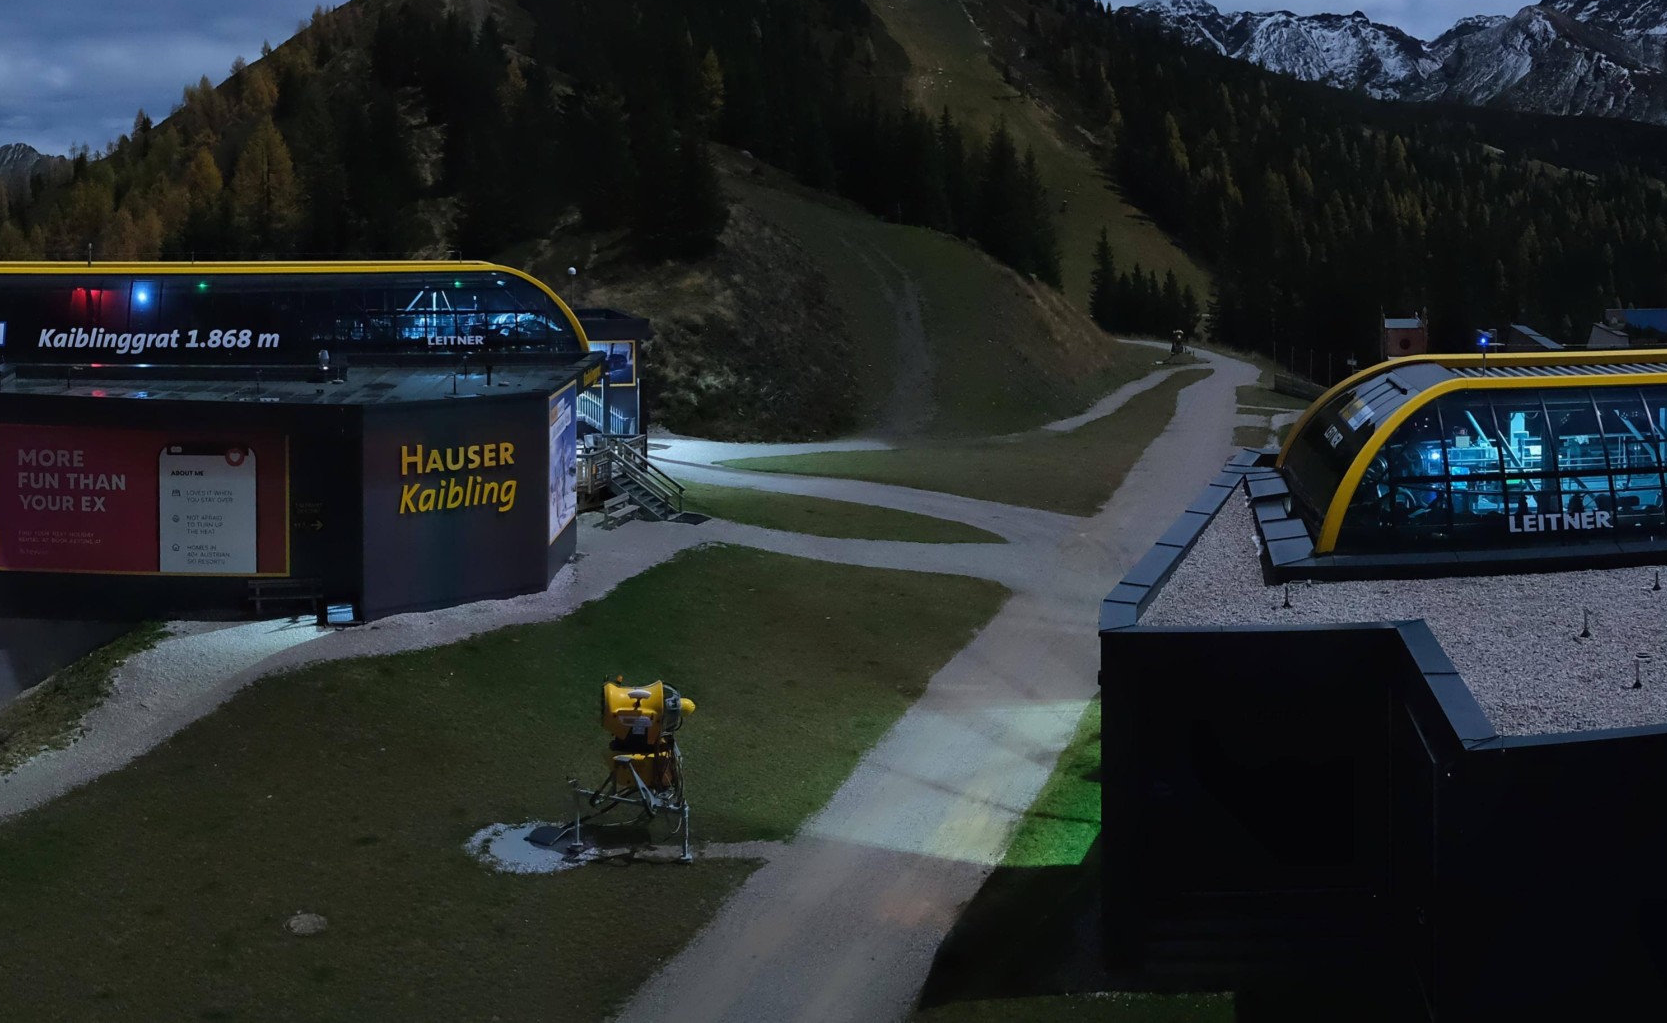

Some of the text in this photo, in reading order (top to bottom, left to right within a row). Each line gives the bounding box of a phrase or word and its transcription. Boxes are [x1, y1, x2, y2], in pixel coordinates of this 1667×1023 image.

[38, 328, 280, 354] Kaiblinggrat 1.868 m
[427, 335, 484, 345] LEITNER
[18, 449, 84, 467] MORE
[401, 442, 515, 475] HAUSER
[18, 472, 126, 490] FUN THAN
[19, 494, 106, 512] YOUR EX
[400, 475, 517, 514] Kaibling
[1509, 511, 1614, 533] LEITNER
